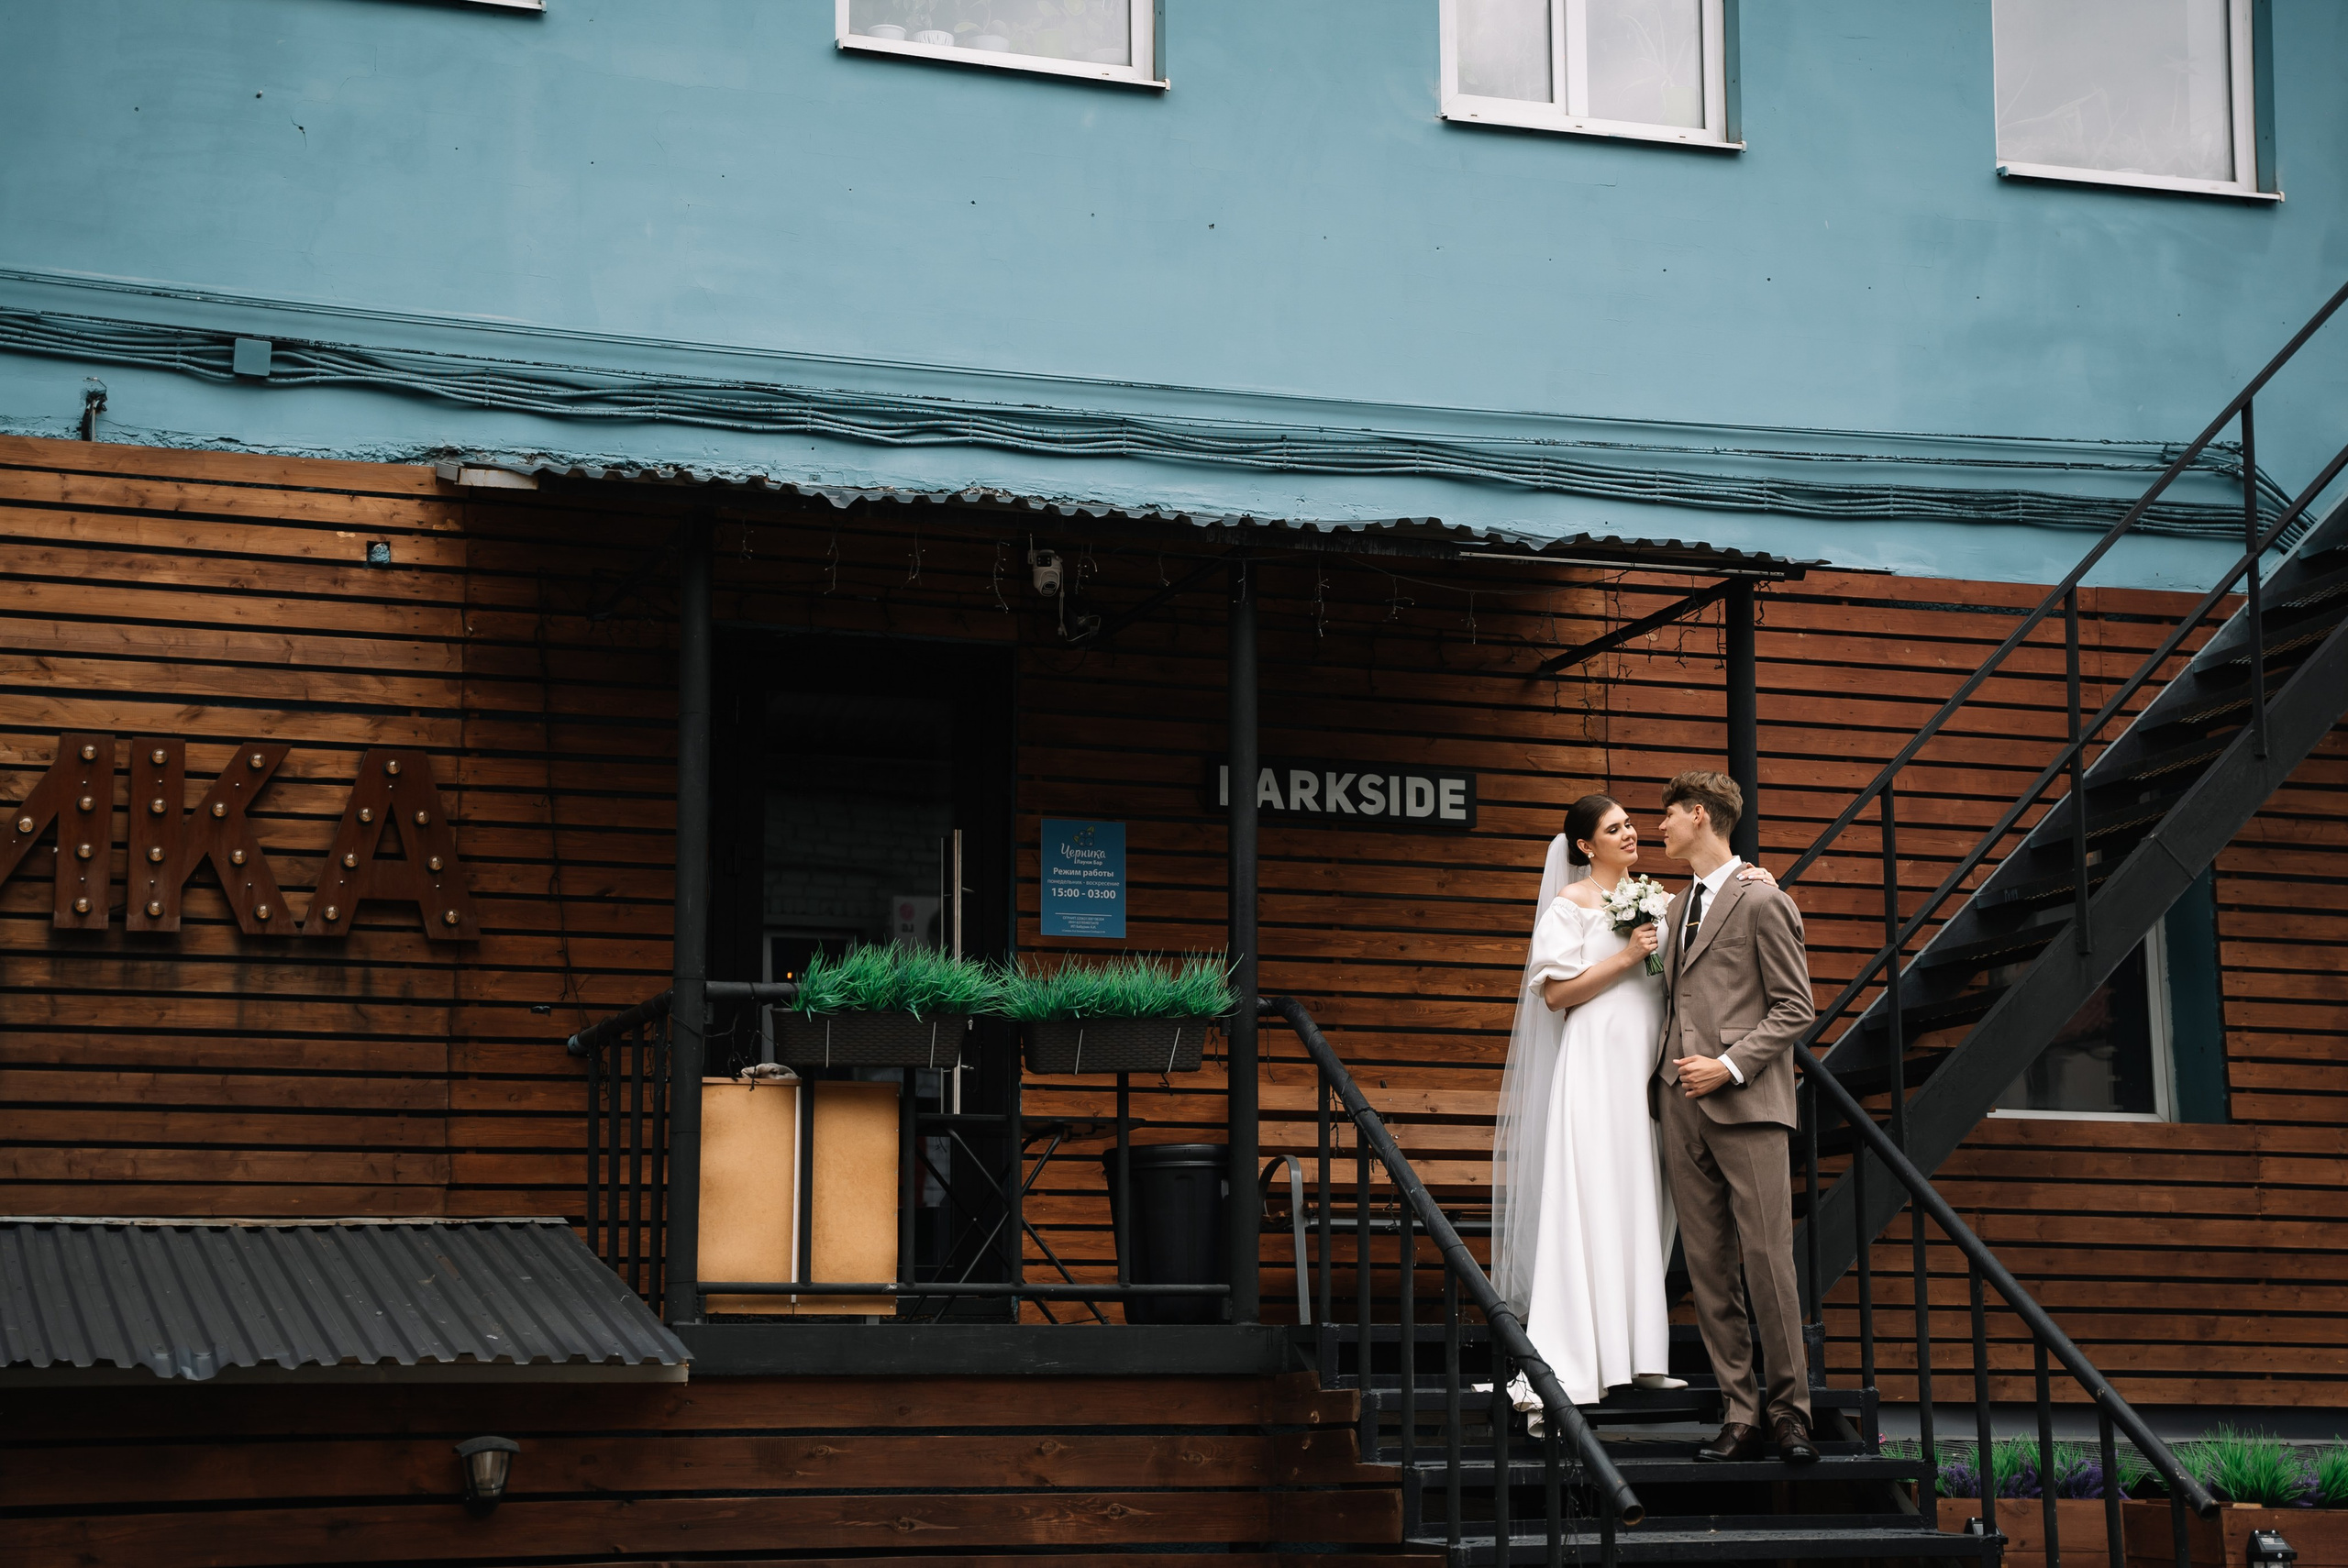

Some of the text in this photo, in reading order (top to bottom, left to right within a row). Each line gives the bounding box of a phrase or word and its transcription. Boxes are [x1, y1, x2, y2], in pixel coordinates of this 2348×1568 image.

[1060, 843, 1106, 864] Черника
[1053, 867, 1114, 878] Режим работы
[1051, 888, 1080, 898] 15:00
[1087, 889, 1116, 900] 03:00
